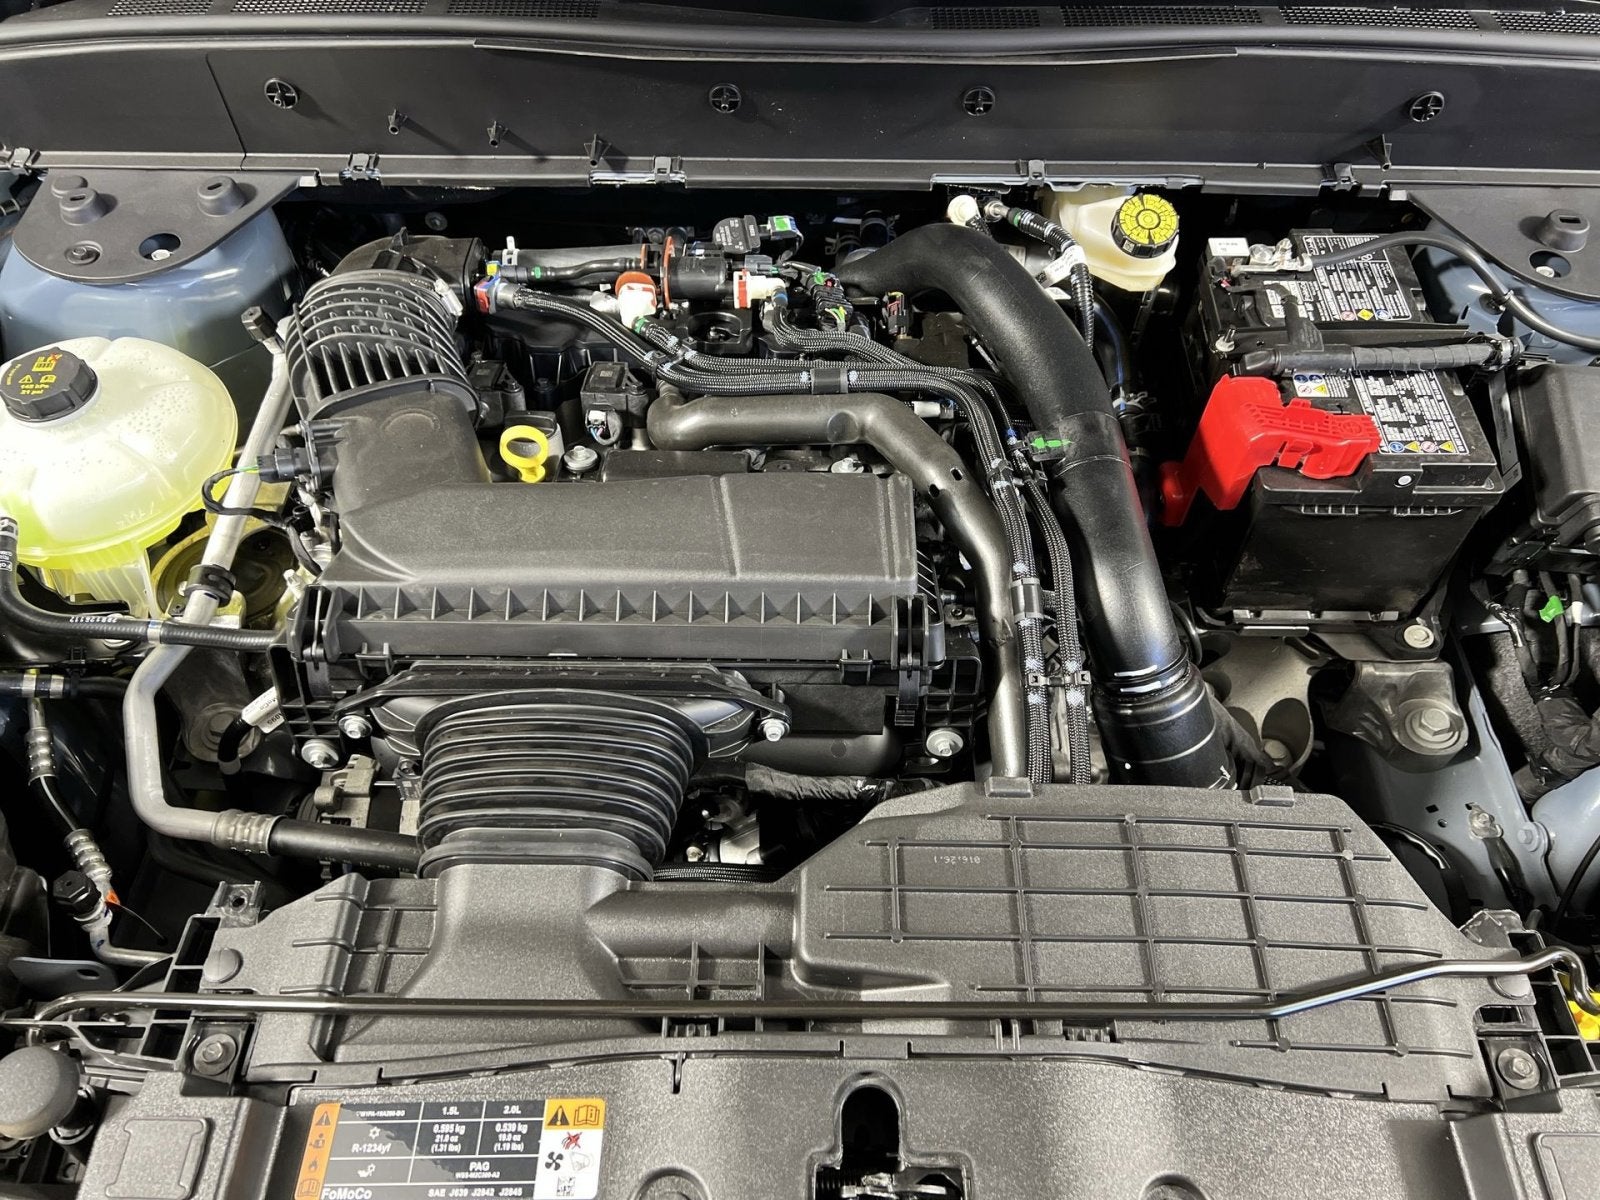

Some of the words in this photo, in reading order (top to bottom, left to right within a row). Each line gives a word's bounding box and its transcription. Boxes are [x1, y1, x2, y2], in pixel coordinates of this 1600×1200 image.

[442, 1106, 460, 1116] 1.5L
[502, 1105, 522, 1115] 2.0L
[455, 1124, 466, 1135] kg
[517, 1122, 528, 1134] kg
[351, 1143, 392, 1155] R-1234yf
[469, 1161, 491, 1172] PAG
[320, 1187, 373, 1200] FoMoCo
[428, 1188, 447, 1198] SAE
